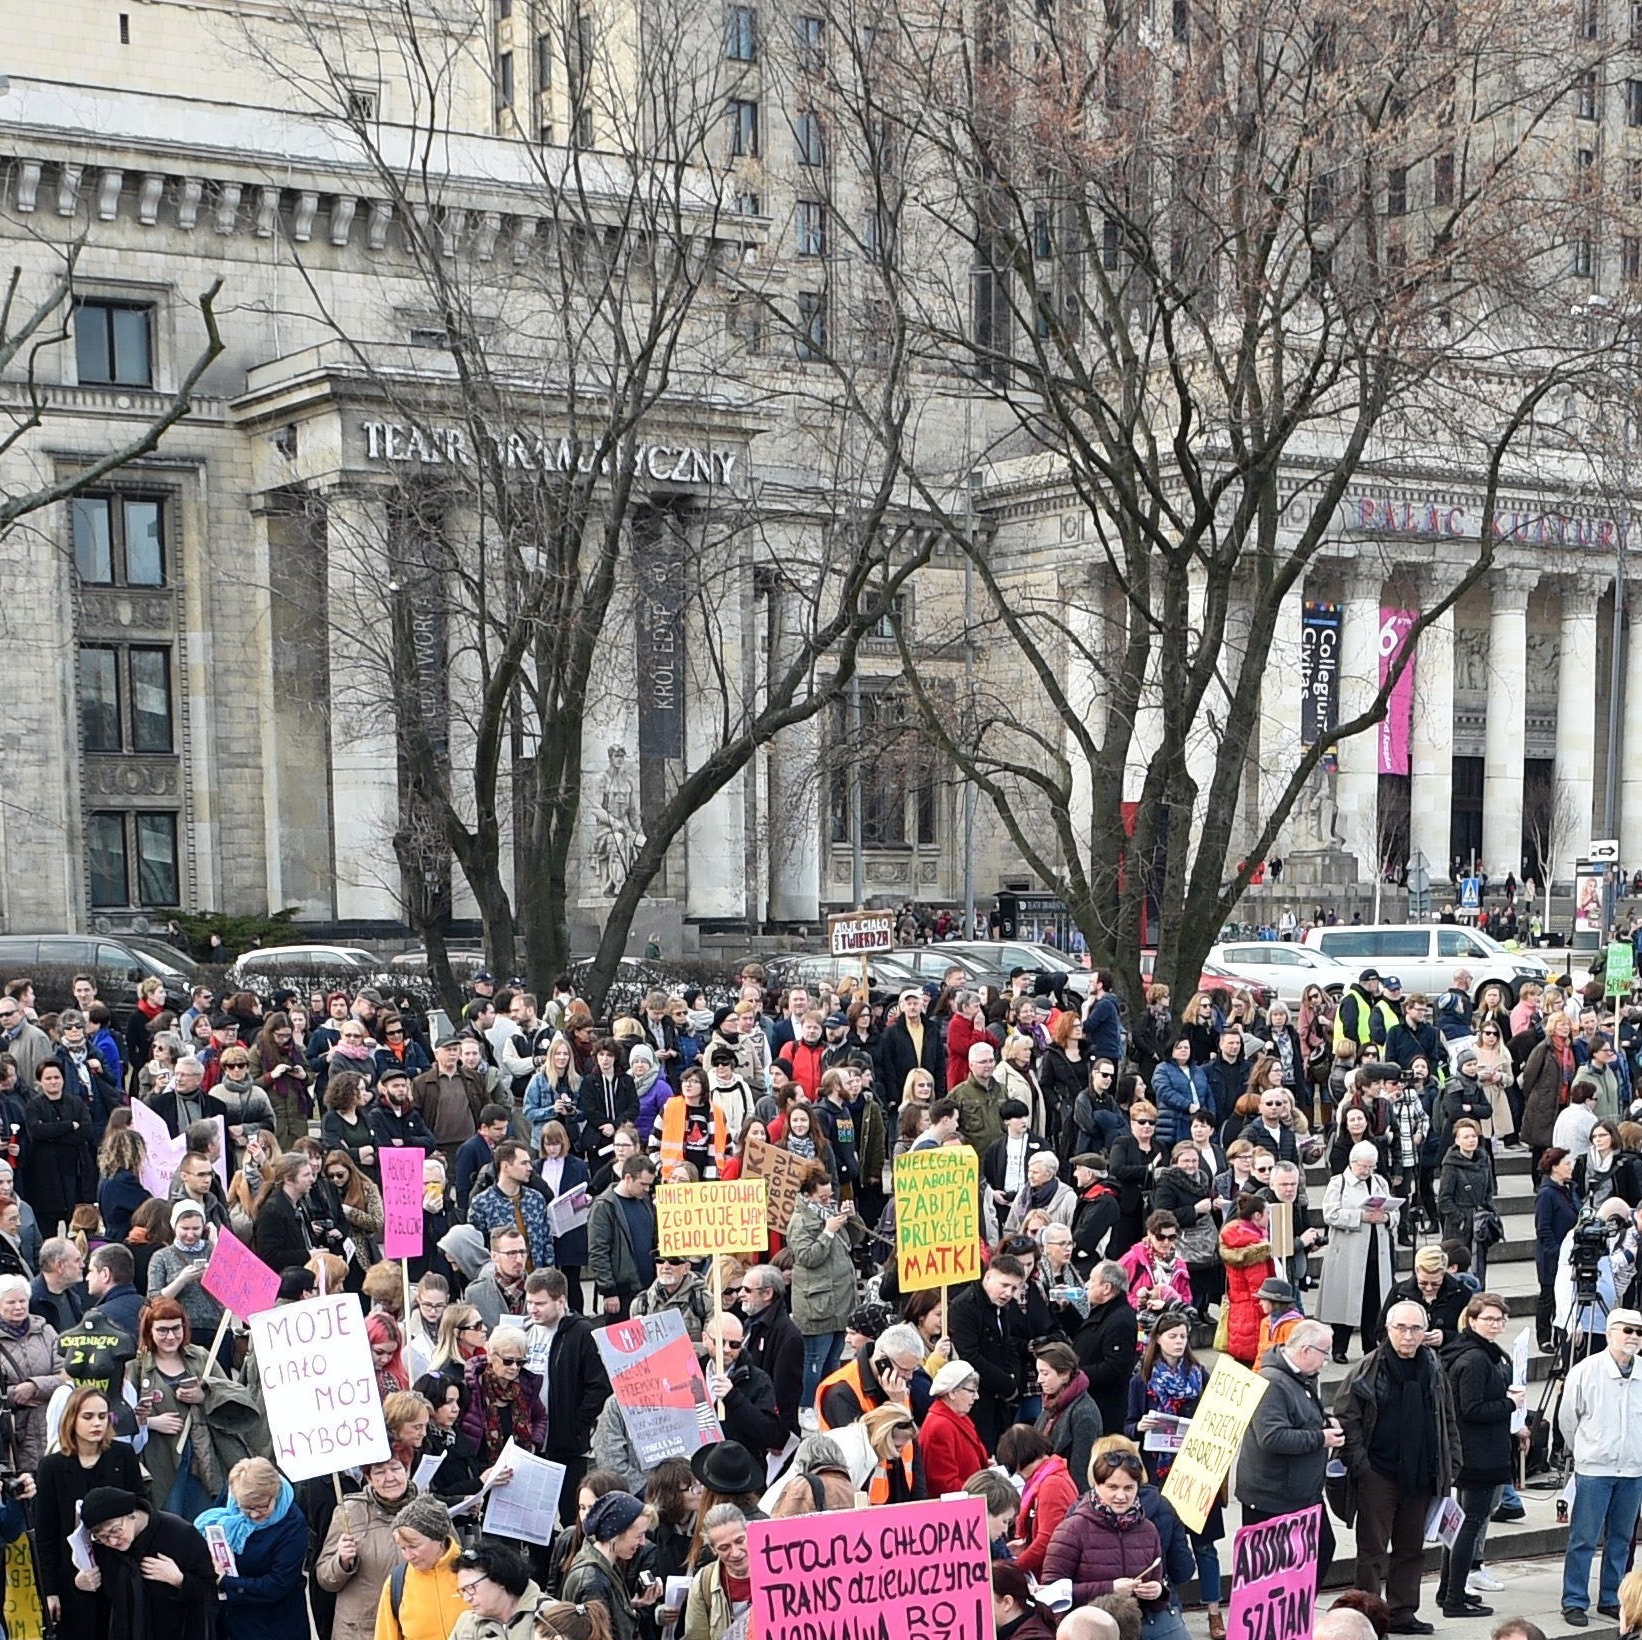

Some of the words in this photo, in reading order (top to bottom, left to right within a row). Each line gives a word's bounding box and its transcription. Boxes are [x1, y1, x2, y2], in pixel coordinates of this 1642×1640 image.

[363, 421, 470, 467] TEATR
[1358, 498, 1466, 537] PAŁAC
[1301, 626, 1317, 700] Civitas
[657, 1187, 694, 1206] UMIEM
[778, 1155, 803, 1231] KOBIET
[895, 1175, 919, 1192] NA
[922, 1167, 976, 1191] ABORCJA
[740, 1205, 768, 1226] WAM
[898, 1189, 973, 1224] ZABIJA
[903, 1243, 977, 1281] MATKI
[266, 1302, 351, 1351] MOJE
[262, 1353, 328, 1390] CIAŁO
[277, 1416, 375, 1459] WYBÓR
[1165, 1466, 1200, 1507] FUCK
[759, 1530, 873, 1576] trans
[879, 1514, 984, 1560] CHŁOPAK
[1234, 1508, 1319, 1588] ABORCJA
[759, 1576, 844, 1624] TRANS
[847, 1559, 989, 1605] dziewczyna
